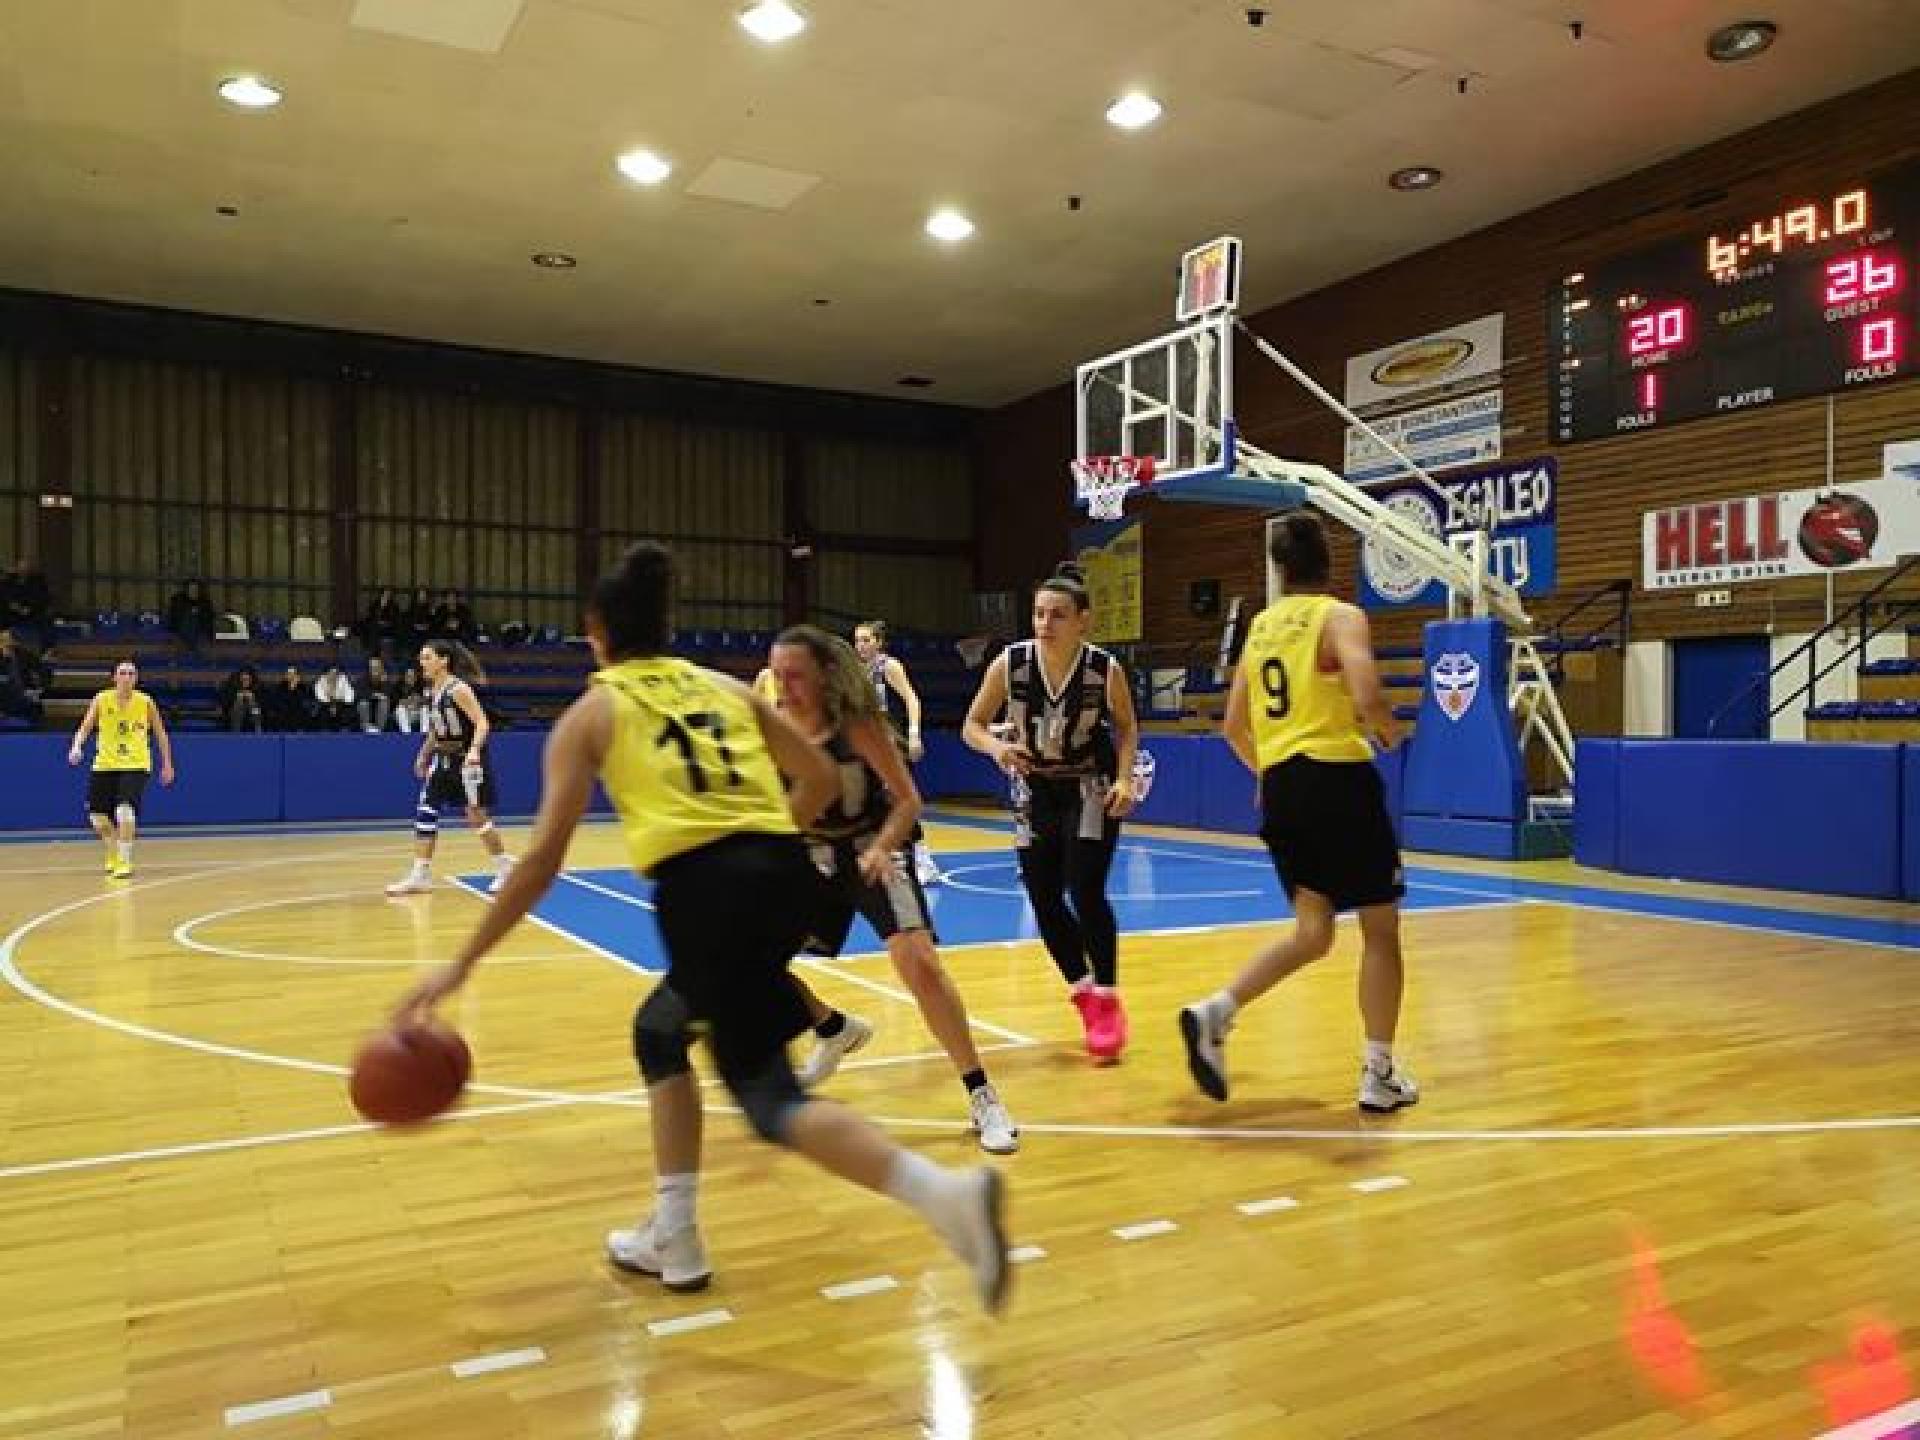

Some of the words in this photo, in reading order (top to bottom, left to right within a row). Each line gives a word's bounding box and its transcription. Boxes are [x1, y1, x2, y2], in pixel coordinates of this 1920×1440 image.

[1826, 255, 1896, 303] 26
[1629, 308, 1684, 352] 20
[1824, 298, 1879, 321] GUEST
[1862, 319, 1896, 361] 0
[1845, 362, 1897, 385] FOULS
[1717, 387, 1774, 409] PLAYER
[1617, 411, 1656, 430] FOULS
[1445, 468, 1549, 531] EGALEO
[1655, 497, 1789, 573] HELL
[1656, 569, 1723, 586] ENERGY
[1730, 563, 1787, 578] DRINK
[1261, 657, 1291, 718] 9
[654, 710, 744, 793] 17
